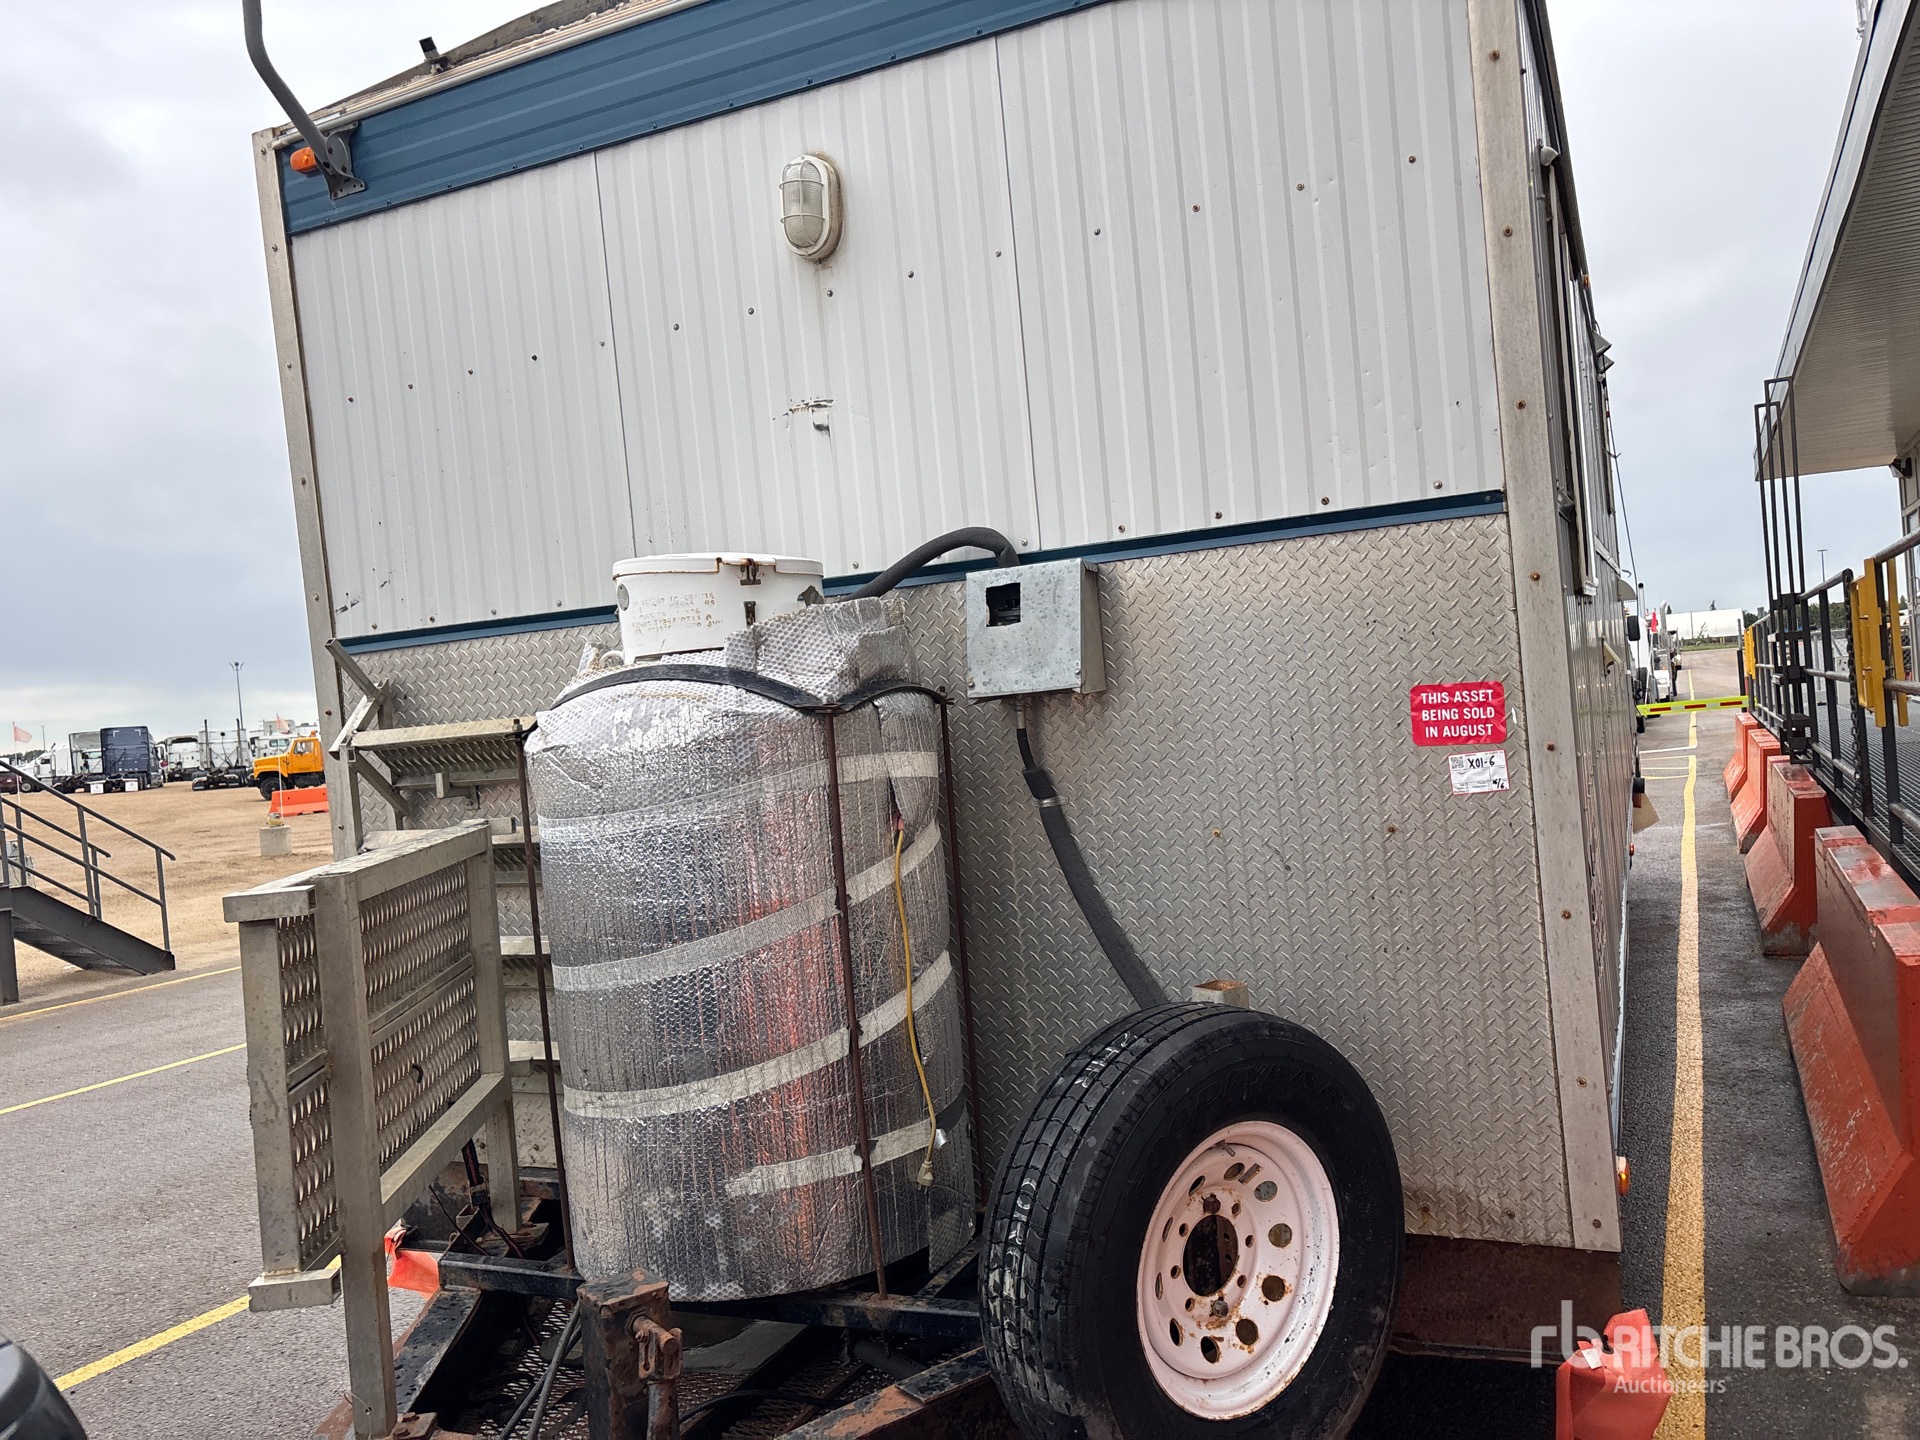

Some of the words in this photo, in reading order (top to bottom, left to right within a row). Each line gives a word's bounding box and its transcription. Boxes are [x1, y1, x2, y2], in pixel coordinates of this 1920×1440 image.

[1421, 691, 1450, 704] THIS
[1454, 690, 1494, 703] ASSET
[1422, 709, 1459, 721] BEING
[1463, 707, 1495, 719] SOLD
[1425, 726, 1439, 738] IN
[1443, 724, 1494, 737] AUGUST
